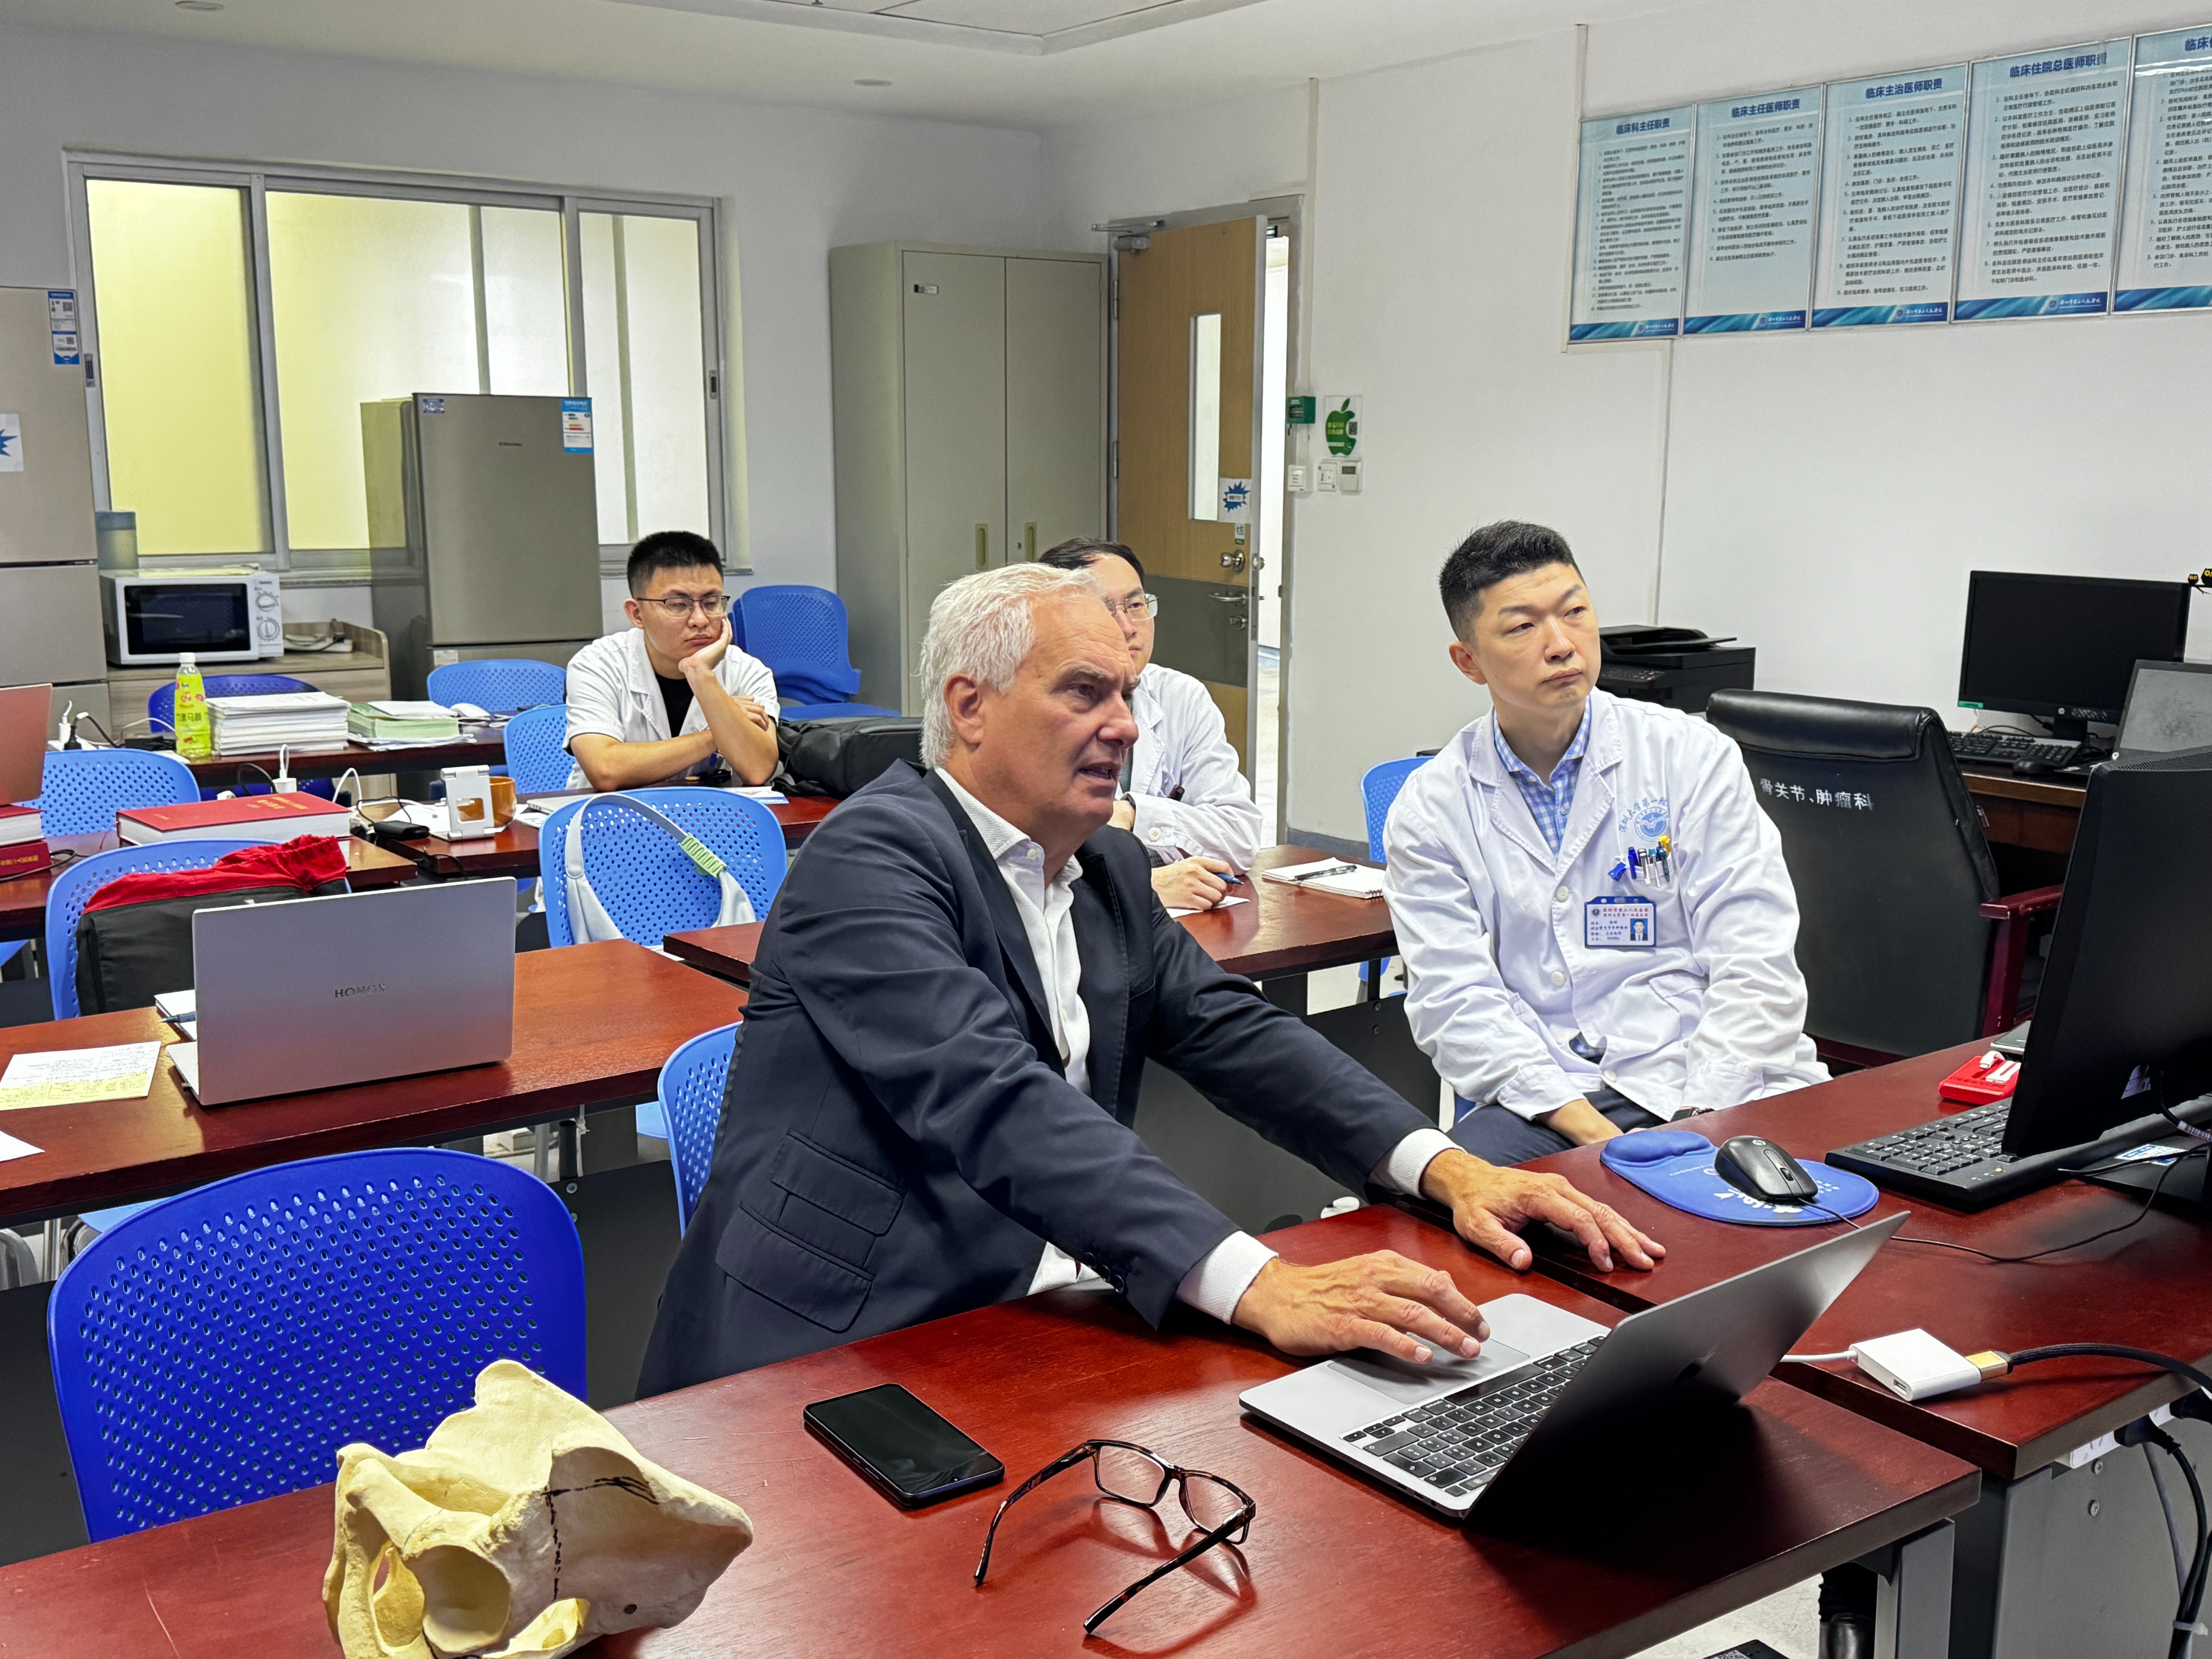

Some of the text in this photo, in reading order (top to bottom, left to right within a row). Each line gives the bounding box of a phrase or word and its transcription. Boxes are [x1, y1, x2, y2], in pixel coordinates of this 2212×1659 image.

[2185, 37, 2212, 51] 临床
[2009, 52, 2108, 78] 临床住院总医师职责
[1865, 78, 1943, 99] 临床主治医师职责
[1732, 99, 1800, 118] 临床主任医师职责
[1616, 118, 1670, 135] 临床科主任职责
[1759, 778, 1876, 811] 骨关节、肿瘤科
